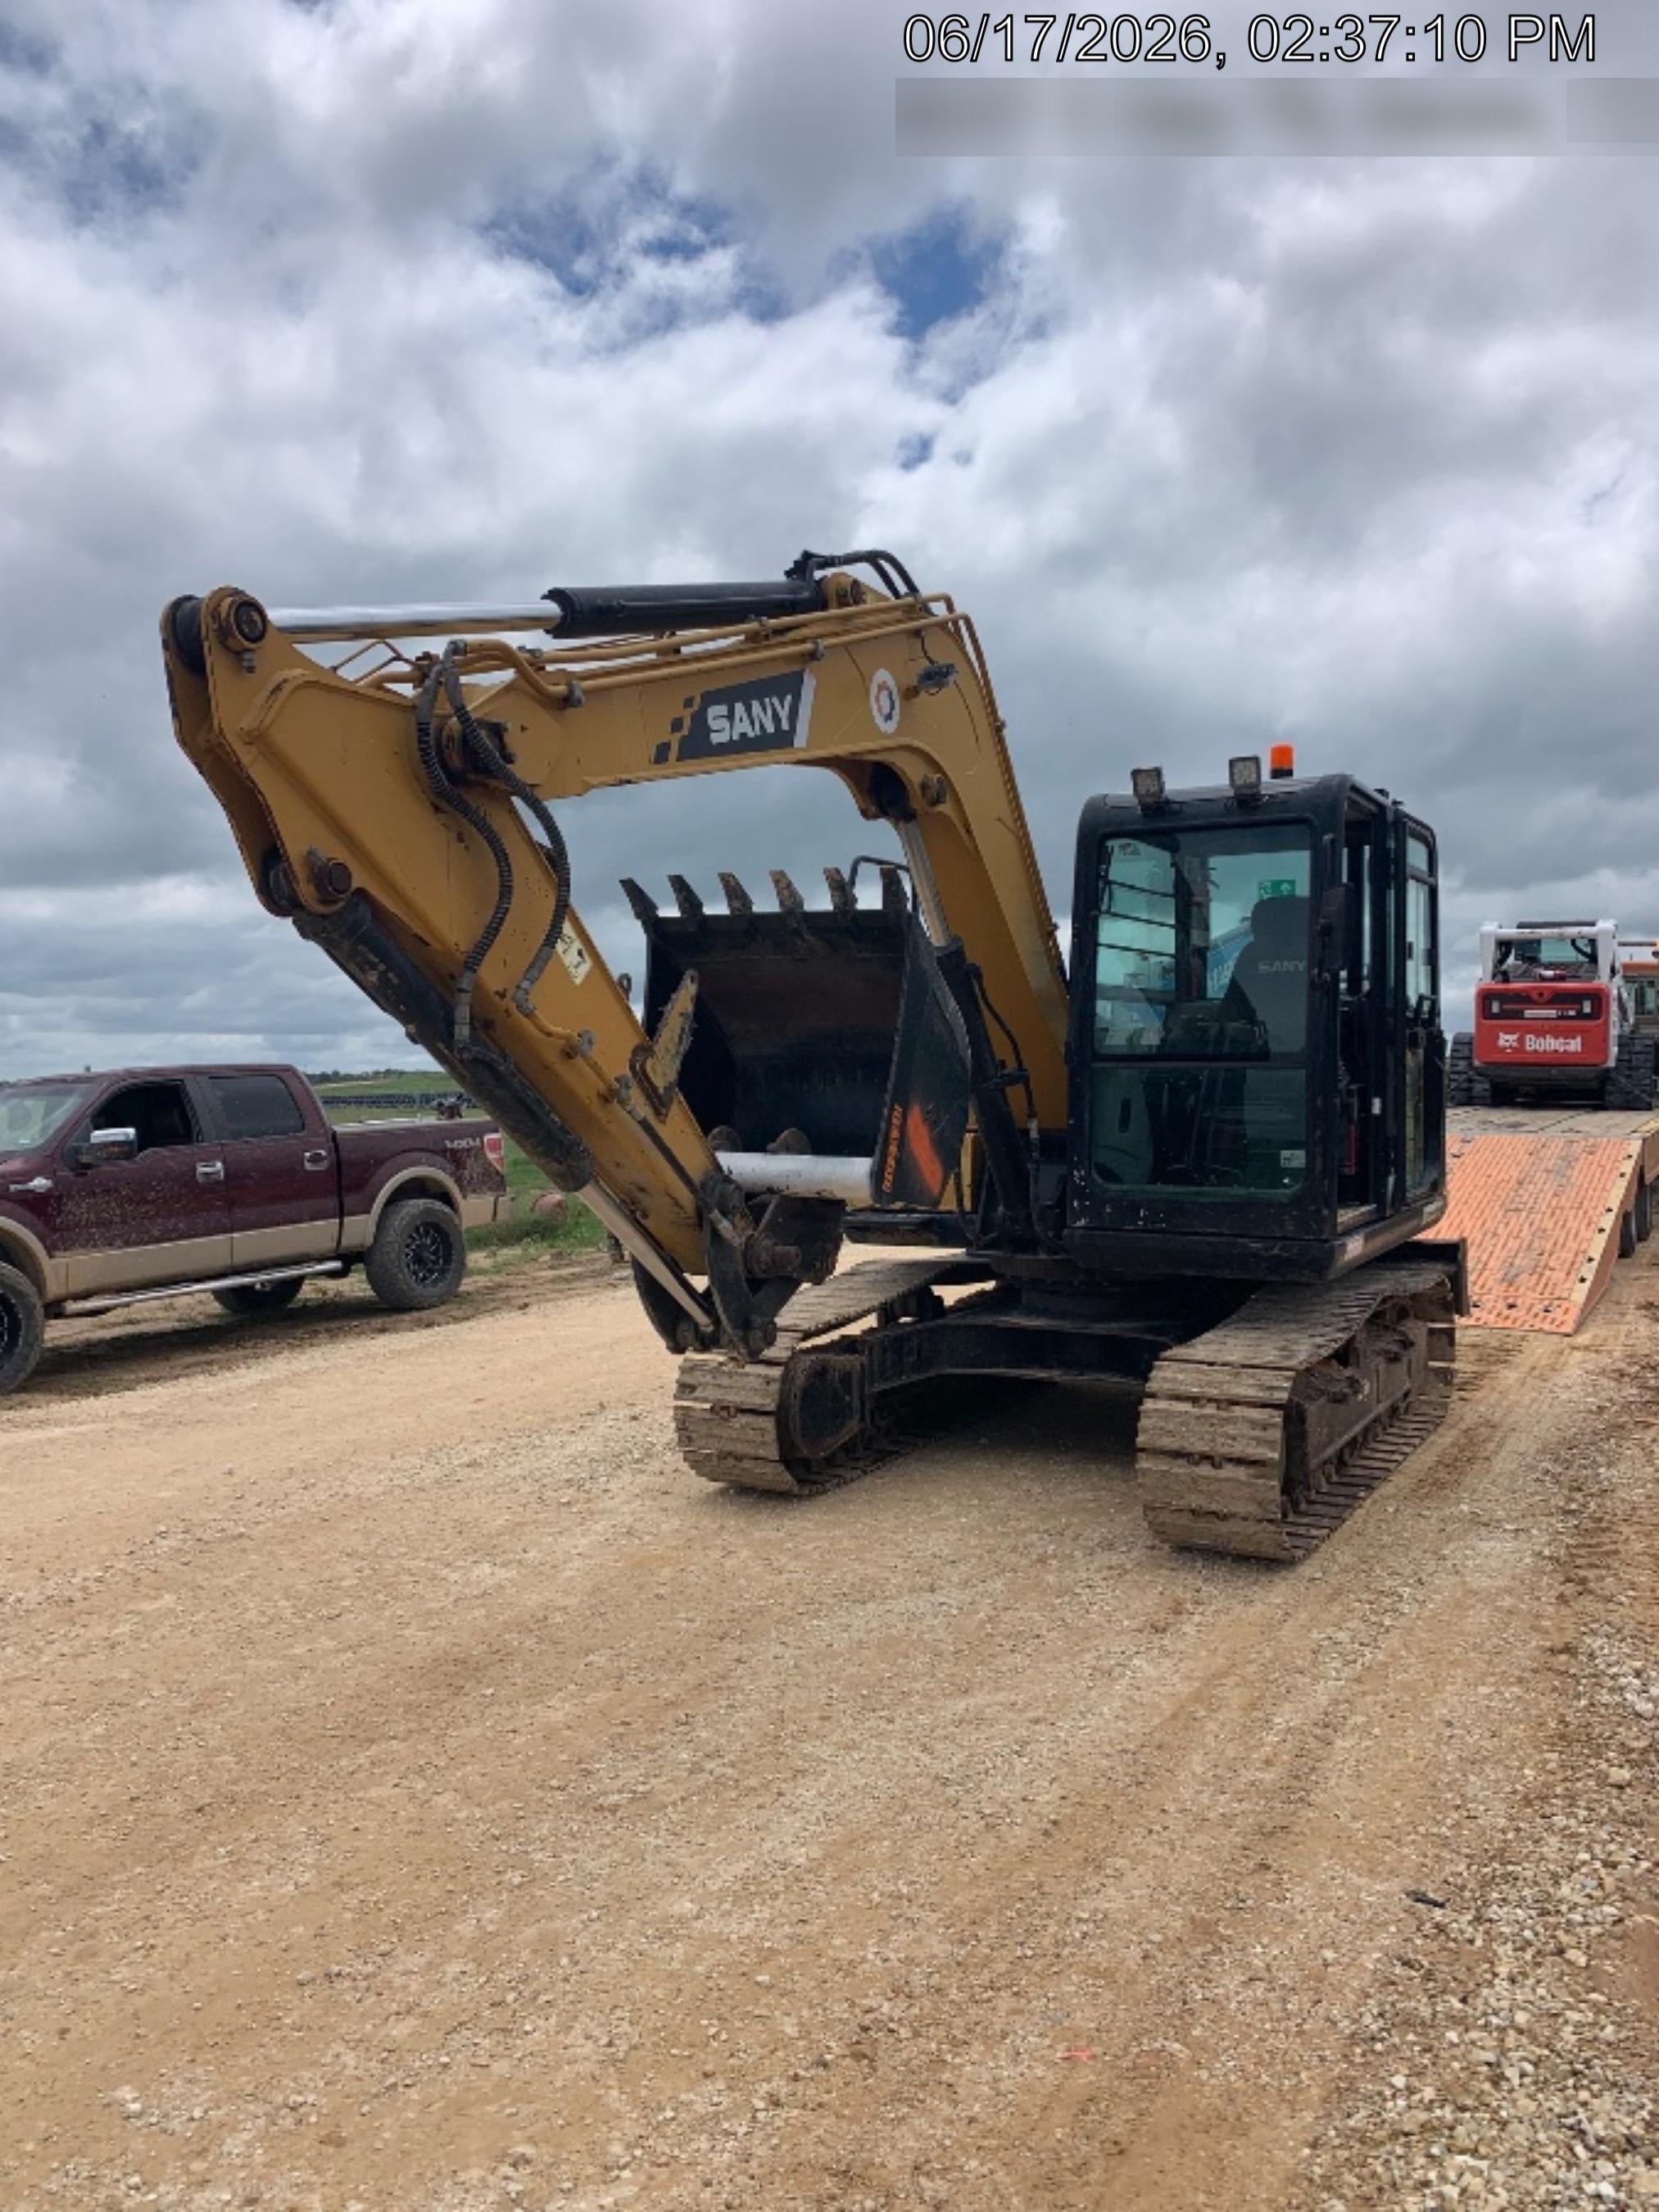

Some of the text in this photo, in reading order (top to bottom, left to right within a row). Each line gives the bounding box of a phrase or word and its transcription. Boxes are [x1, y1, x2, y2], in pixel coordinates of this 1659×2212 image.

[707, 693, 792, 745] SANY
[1258, 960, 1306, 974] SANY
[1525, 1034, 1582, 1053] Bobcat
